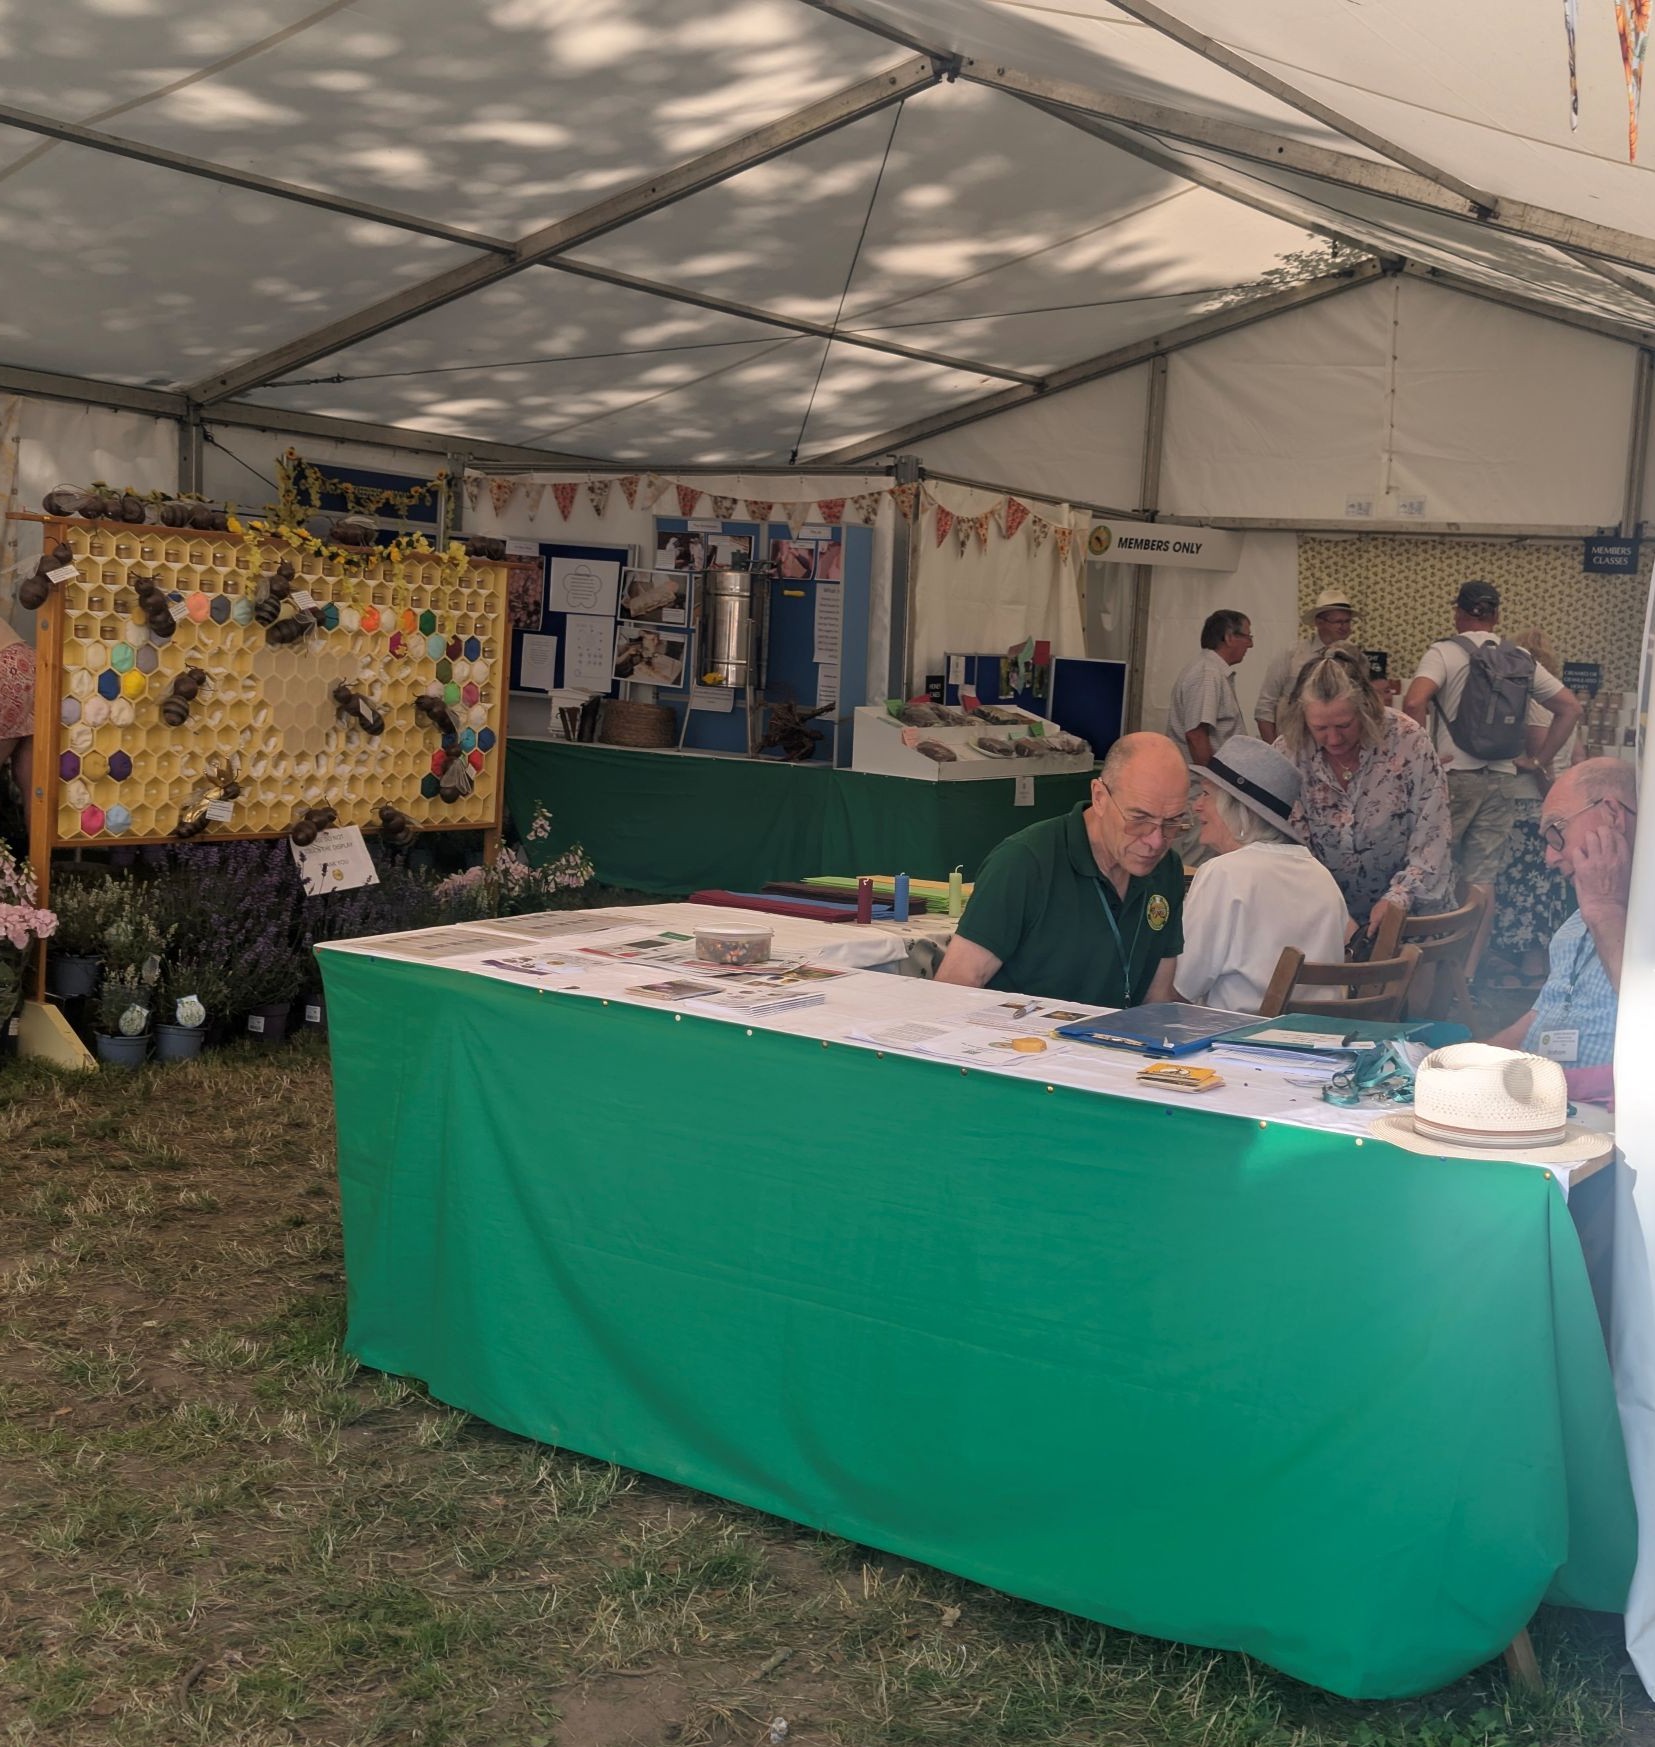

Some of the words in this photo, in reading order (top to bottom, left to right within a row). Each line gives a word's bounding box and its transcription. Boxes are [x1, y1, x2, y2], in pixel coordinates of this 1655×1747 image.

[1117, 537, 1170, 552] MEMBERS
[1172, 541, 1203, 554] ONLY
[1591, 545, 1632, 556] MEMBERS
[1592, 555, 1629, 566] CLASSES
